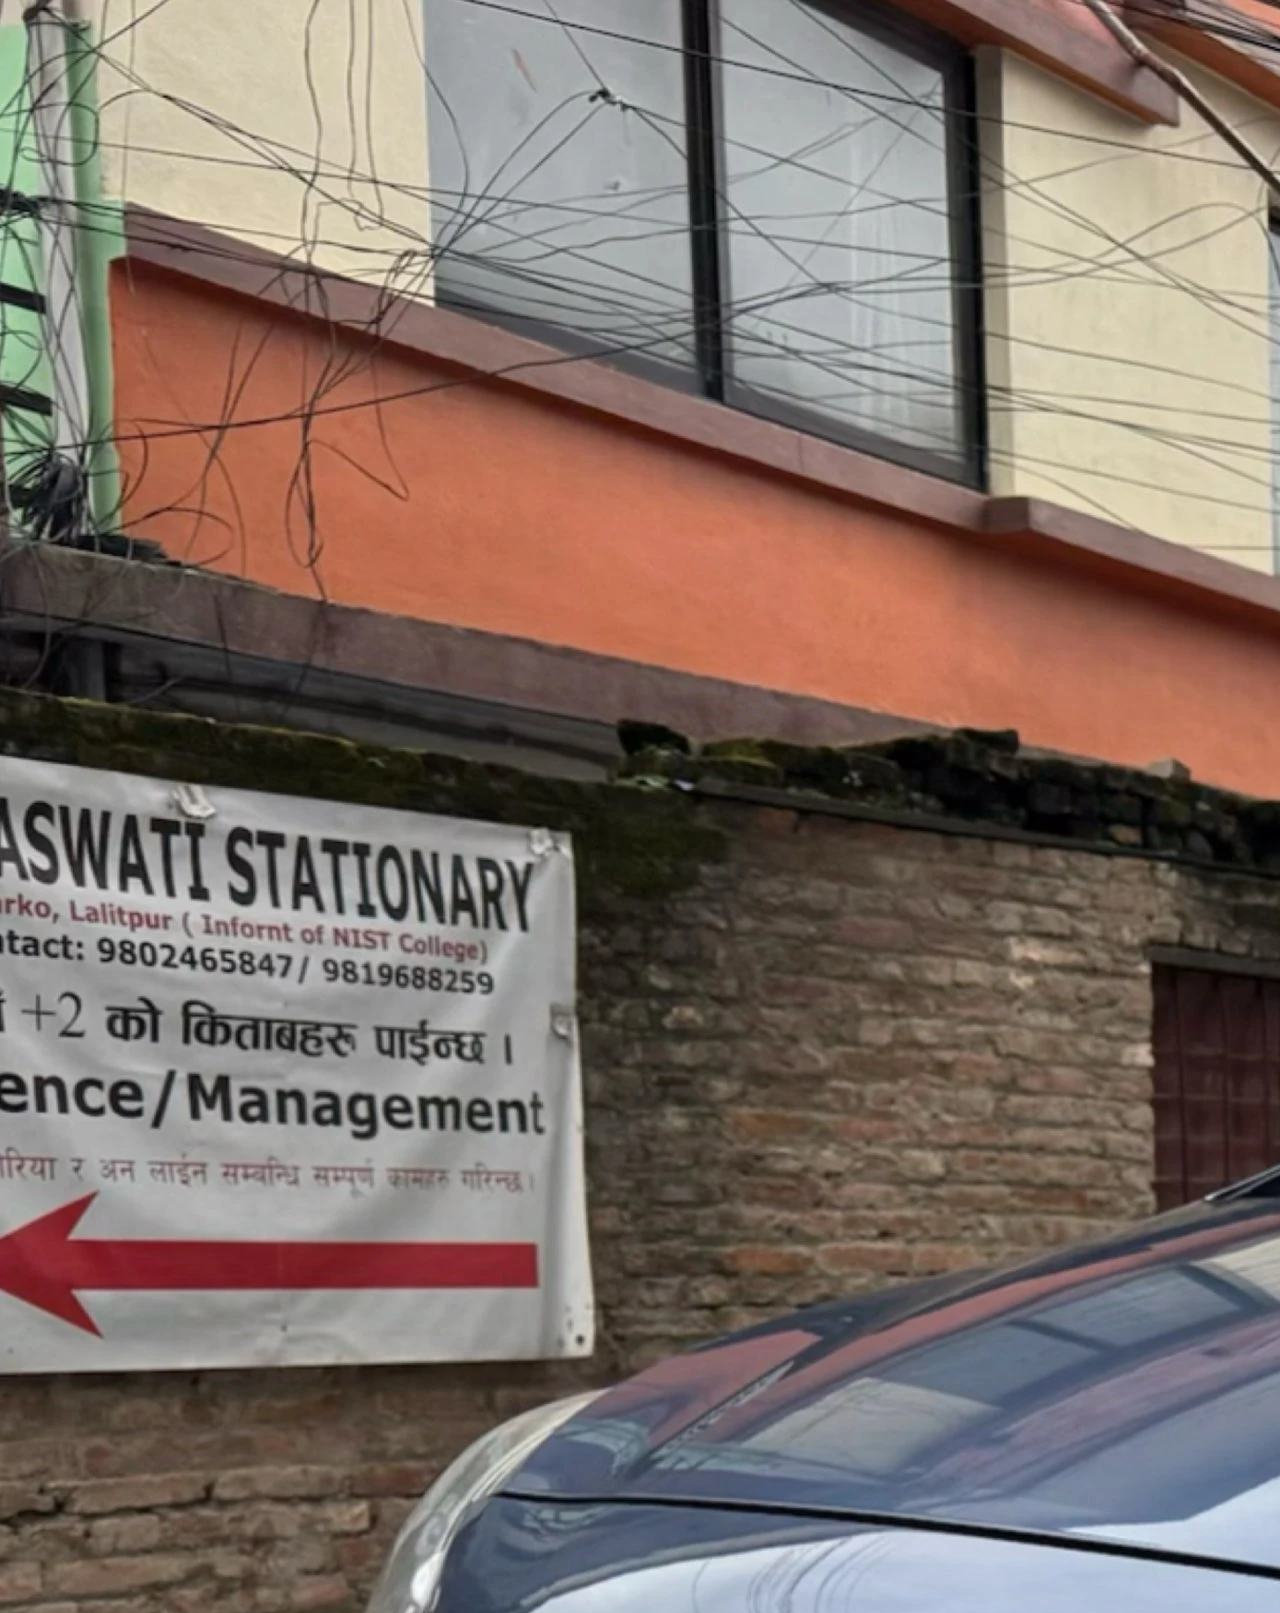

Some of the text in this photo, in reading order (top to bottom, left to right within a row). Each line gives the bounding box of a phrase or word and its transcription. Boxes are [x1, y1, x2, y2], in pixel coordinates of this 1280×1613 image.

[0, 797, 534, 932] ASWATI STATIONARY
[0, 893, 60, 925] rko,
[69, 899, 173, 932] Lalitpur
[300, 925, 325, 945] of
[332, 927, 391, 951] NIST
[399, 934, 488, 965] College)
[0, 929, 84, 961] tact:
[322, 959, 495, 995] 9819688259
[21, 991, 86, 1038] +2
[105, 996, 163, 1043] को
